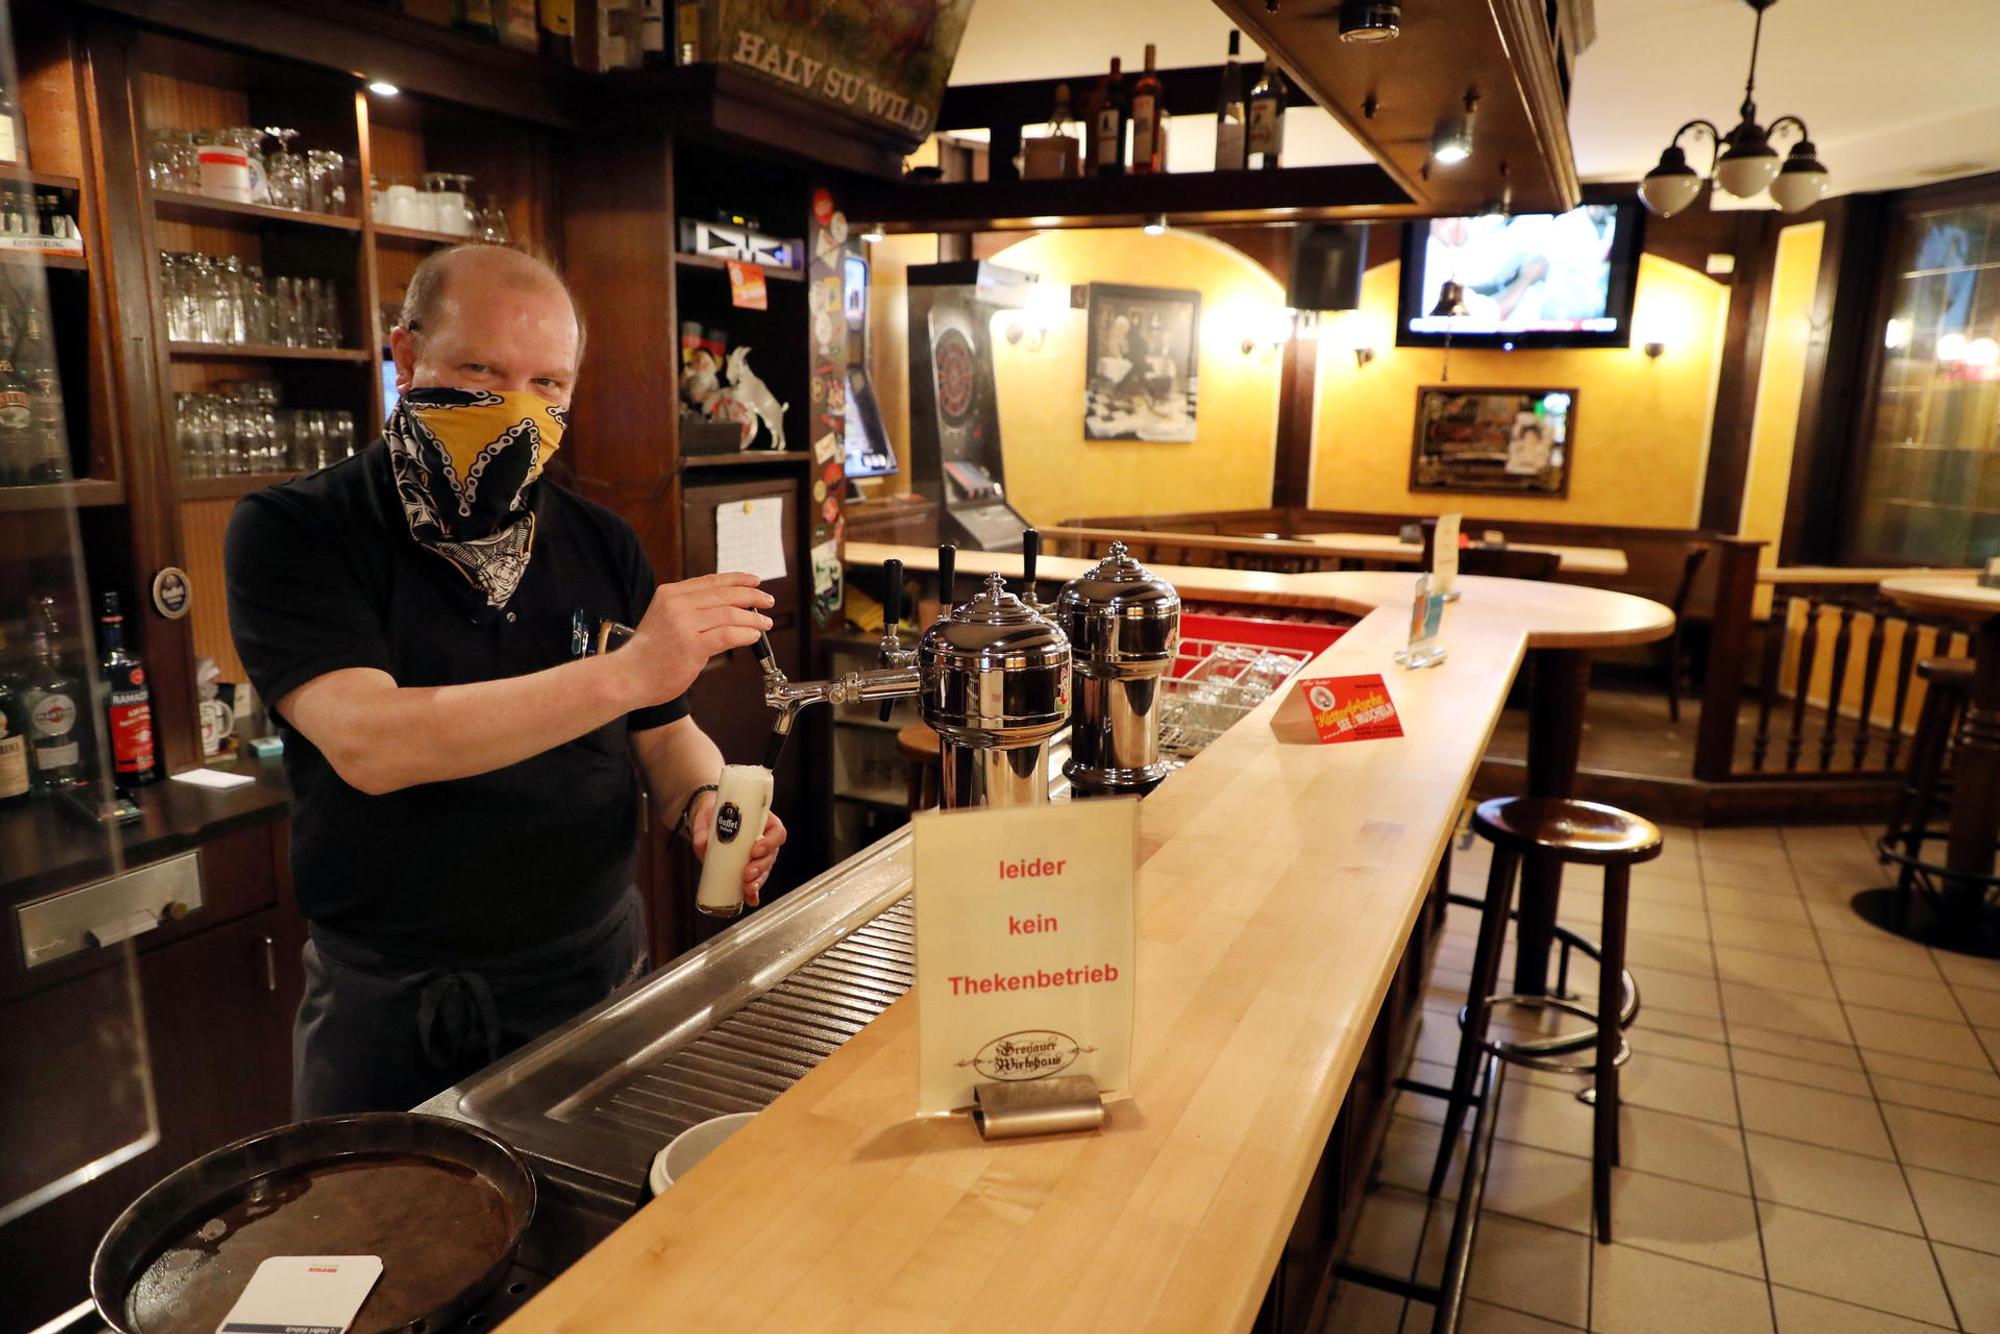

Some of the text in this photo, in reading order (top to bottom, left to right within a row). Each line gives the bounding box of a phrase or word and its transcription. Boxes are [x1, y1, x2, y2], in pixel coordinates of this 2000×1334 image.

[733, 30, 929, 132] HALV SU WILD
[999, 857, 1067, 880] leider
[1008, 914, 1059, 936] kein
[947, 963, 1119, 996] Thekenbetrieb
